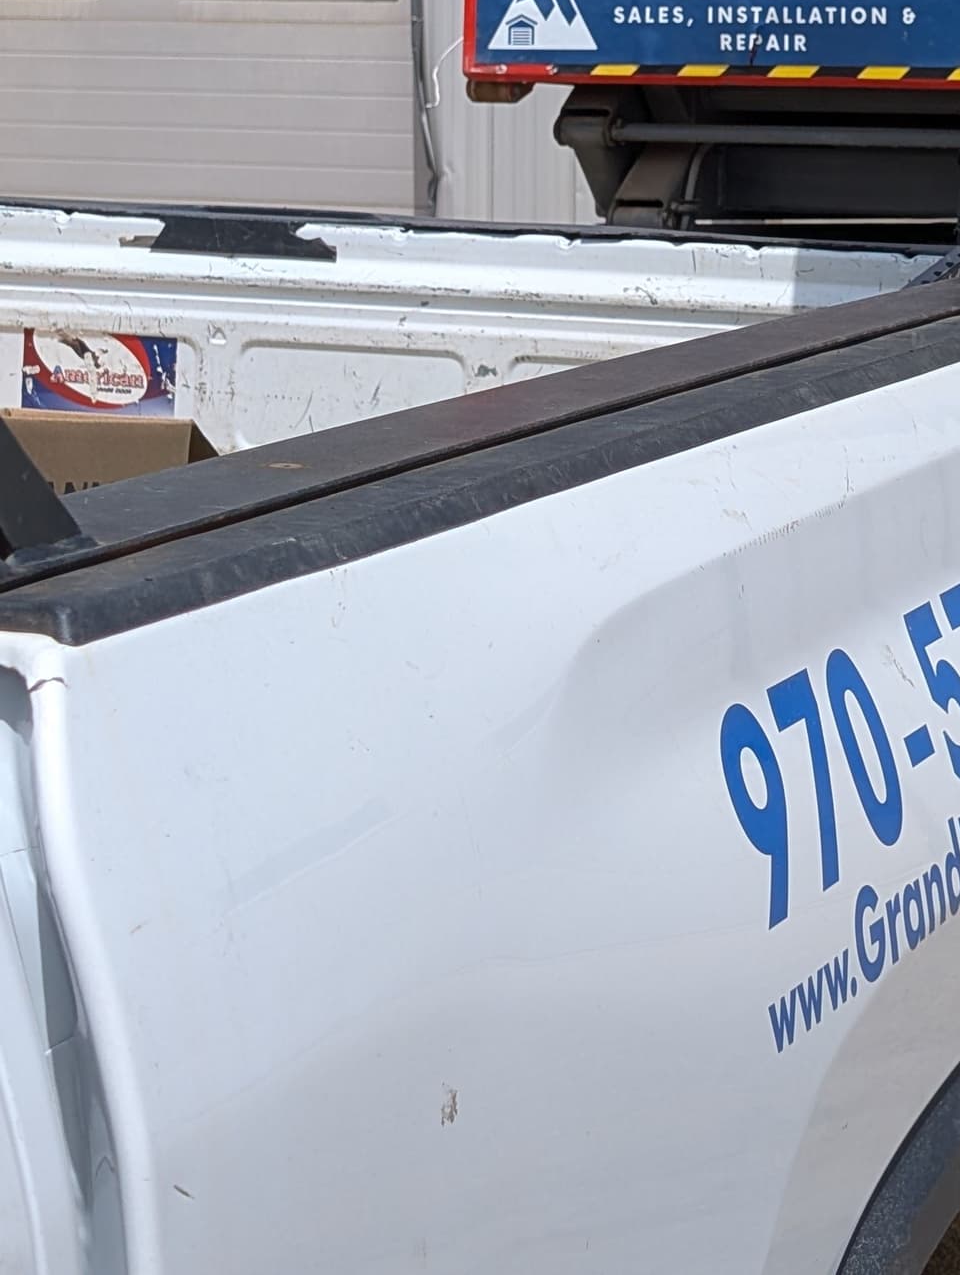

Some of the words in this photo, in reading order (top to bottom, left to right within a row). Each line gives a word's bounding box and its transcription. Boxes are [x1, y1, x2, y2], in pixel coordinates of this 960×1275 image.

[614, 6, 694, 27] SALES,
[707, 6, 887, 25] INSTALLATION
[902, 7, 916, 25] &
[720, 33, 807, 53] REPAIR
[49, 364, 145, 389] Amrican
